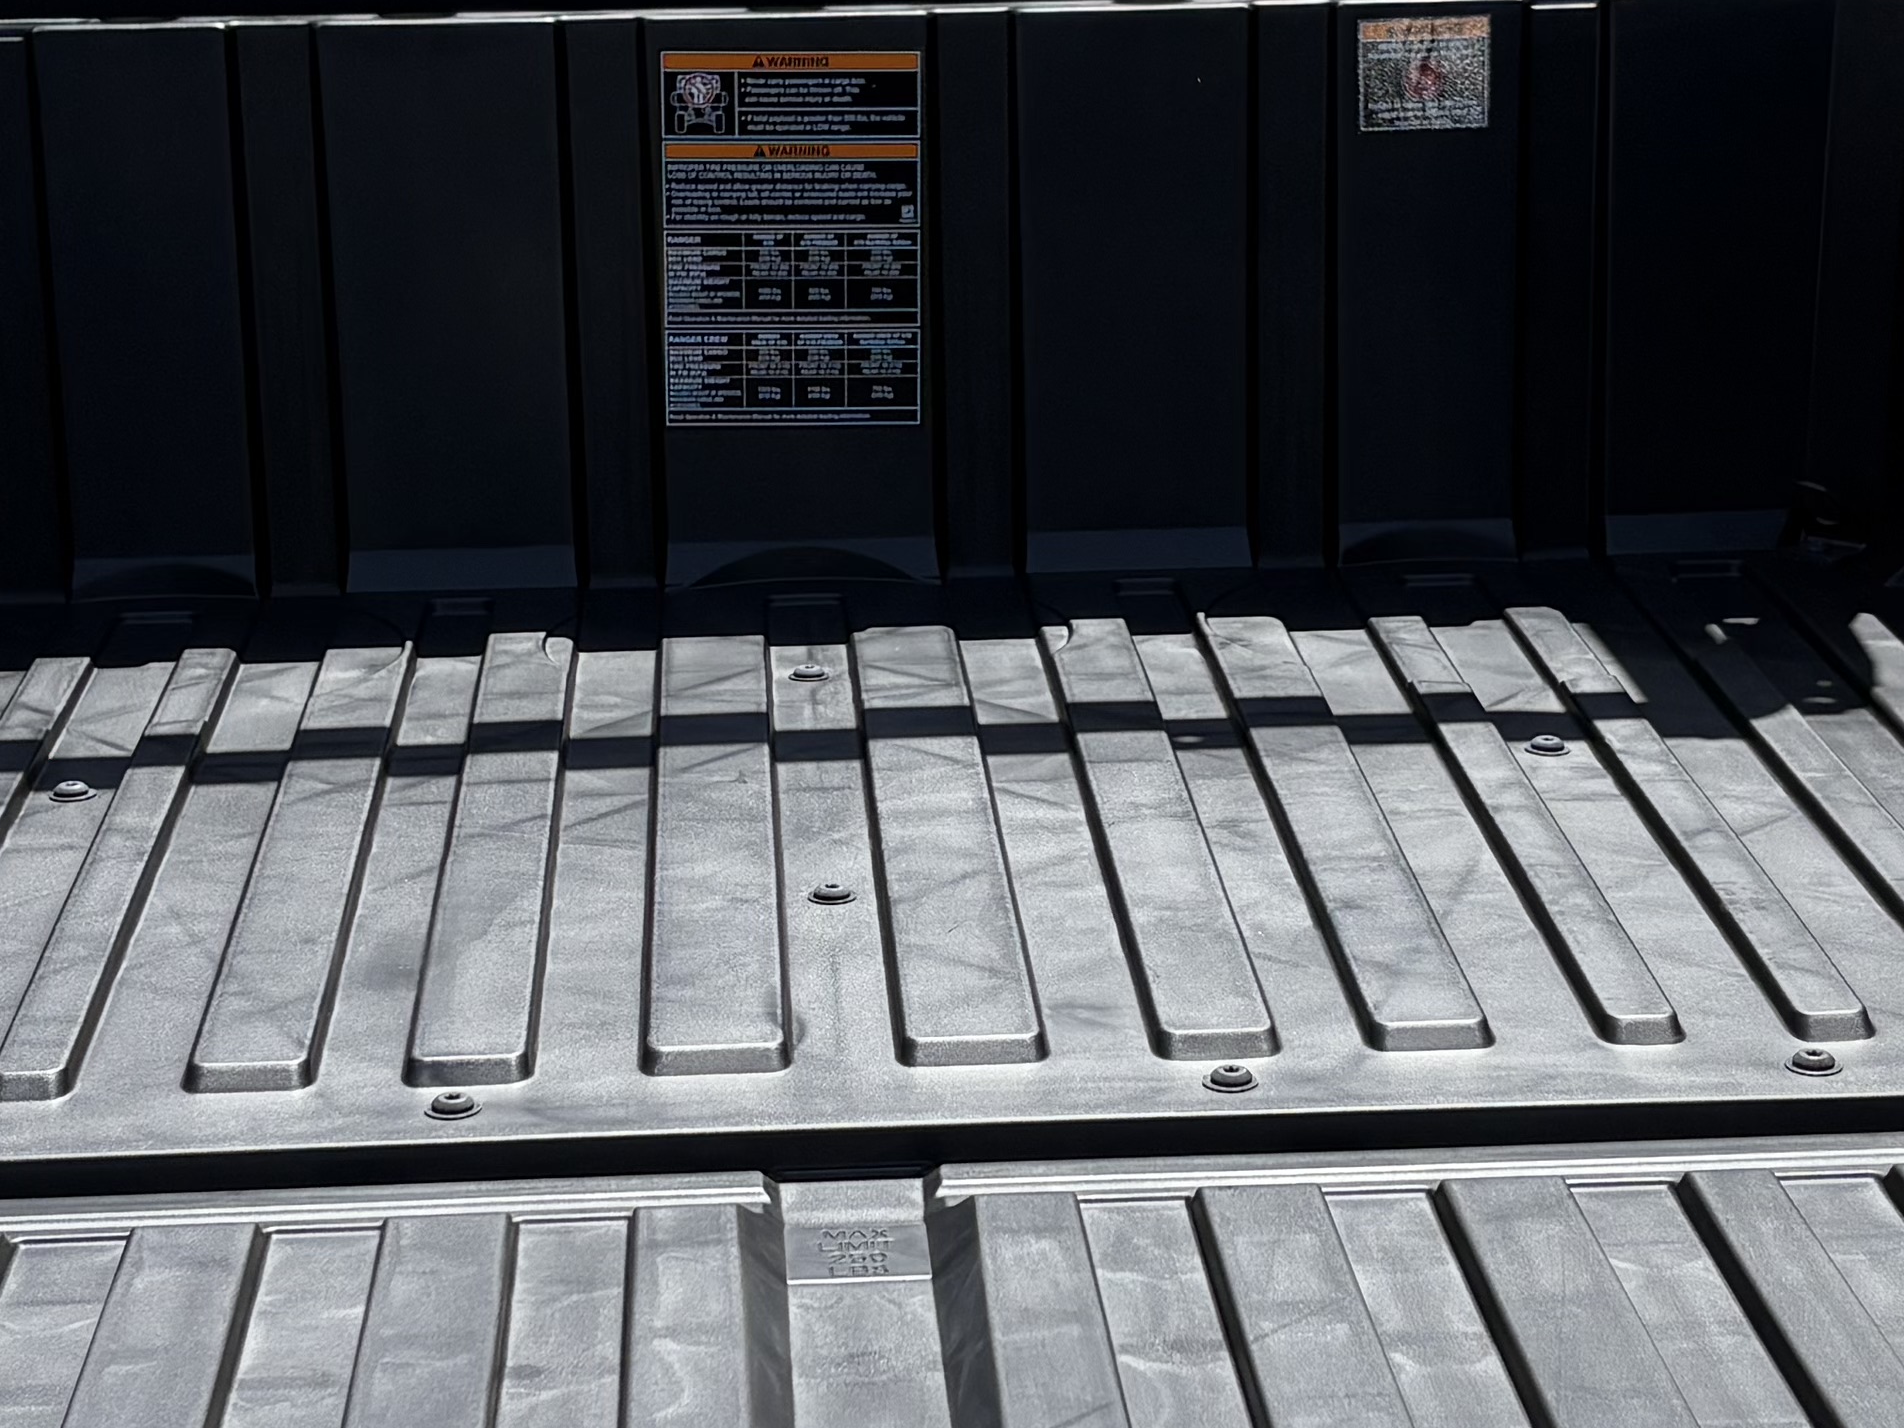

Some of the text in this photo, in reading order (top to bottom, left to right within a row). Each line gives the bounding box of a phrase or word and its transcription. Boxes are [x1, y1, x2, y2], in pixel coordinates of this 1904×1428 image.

[767, 56, 829, 67] WARNING
[769, 145, 830, 156] WARNING
[821, 1228, 890, 1240] MAX
[817, 1239, 894, 1252] LIMIT
[827, 1252, 889, 1265] 250
